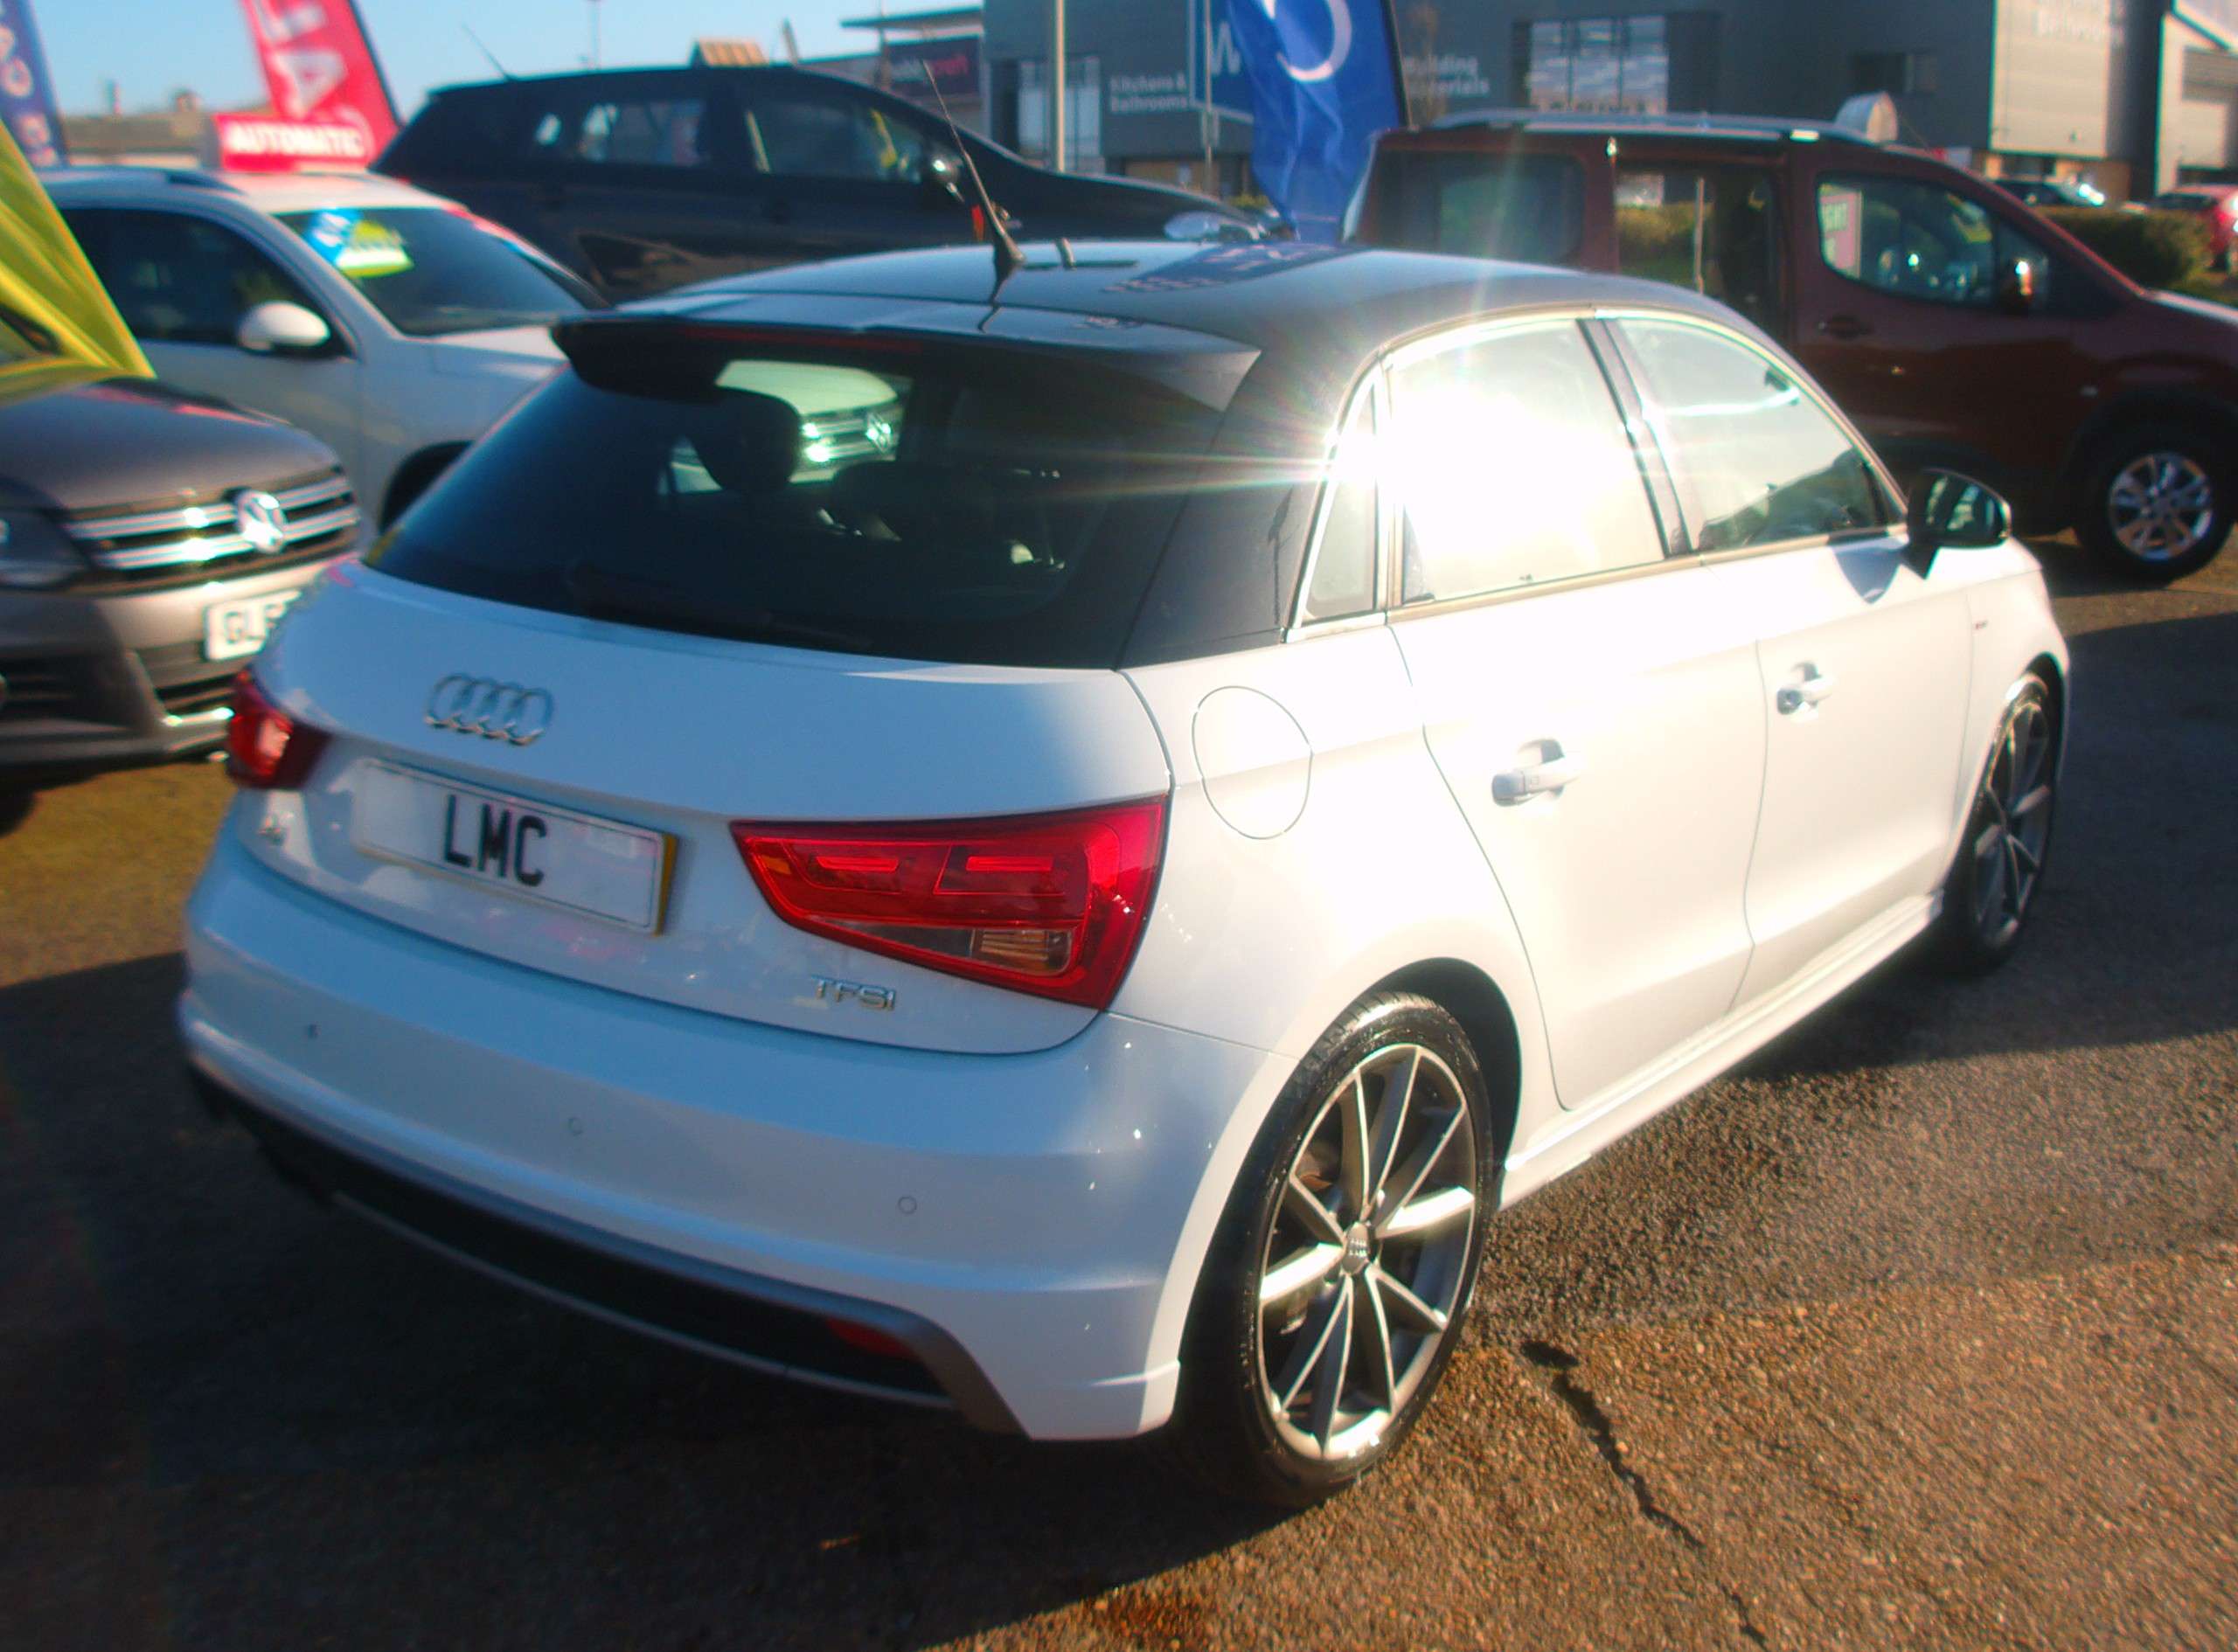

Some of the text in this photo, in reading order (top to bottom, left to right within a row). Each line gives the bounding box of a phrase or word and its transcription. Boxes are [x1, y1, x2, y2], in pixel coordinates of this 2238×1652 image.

[226, 121, 365, 157] AUTOMATIC
[444, 794, 547, 888] LMC
[810, 974, 897, 1011] TFSI
